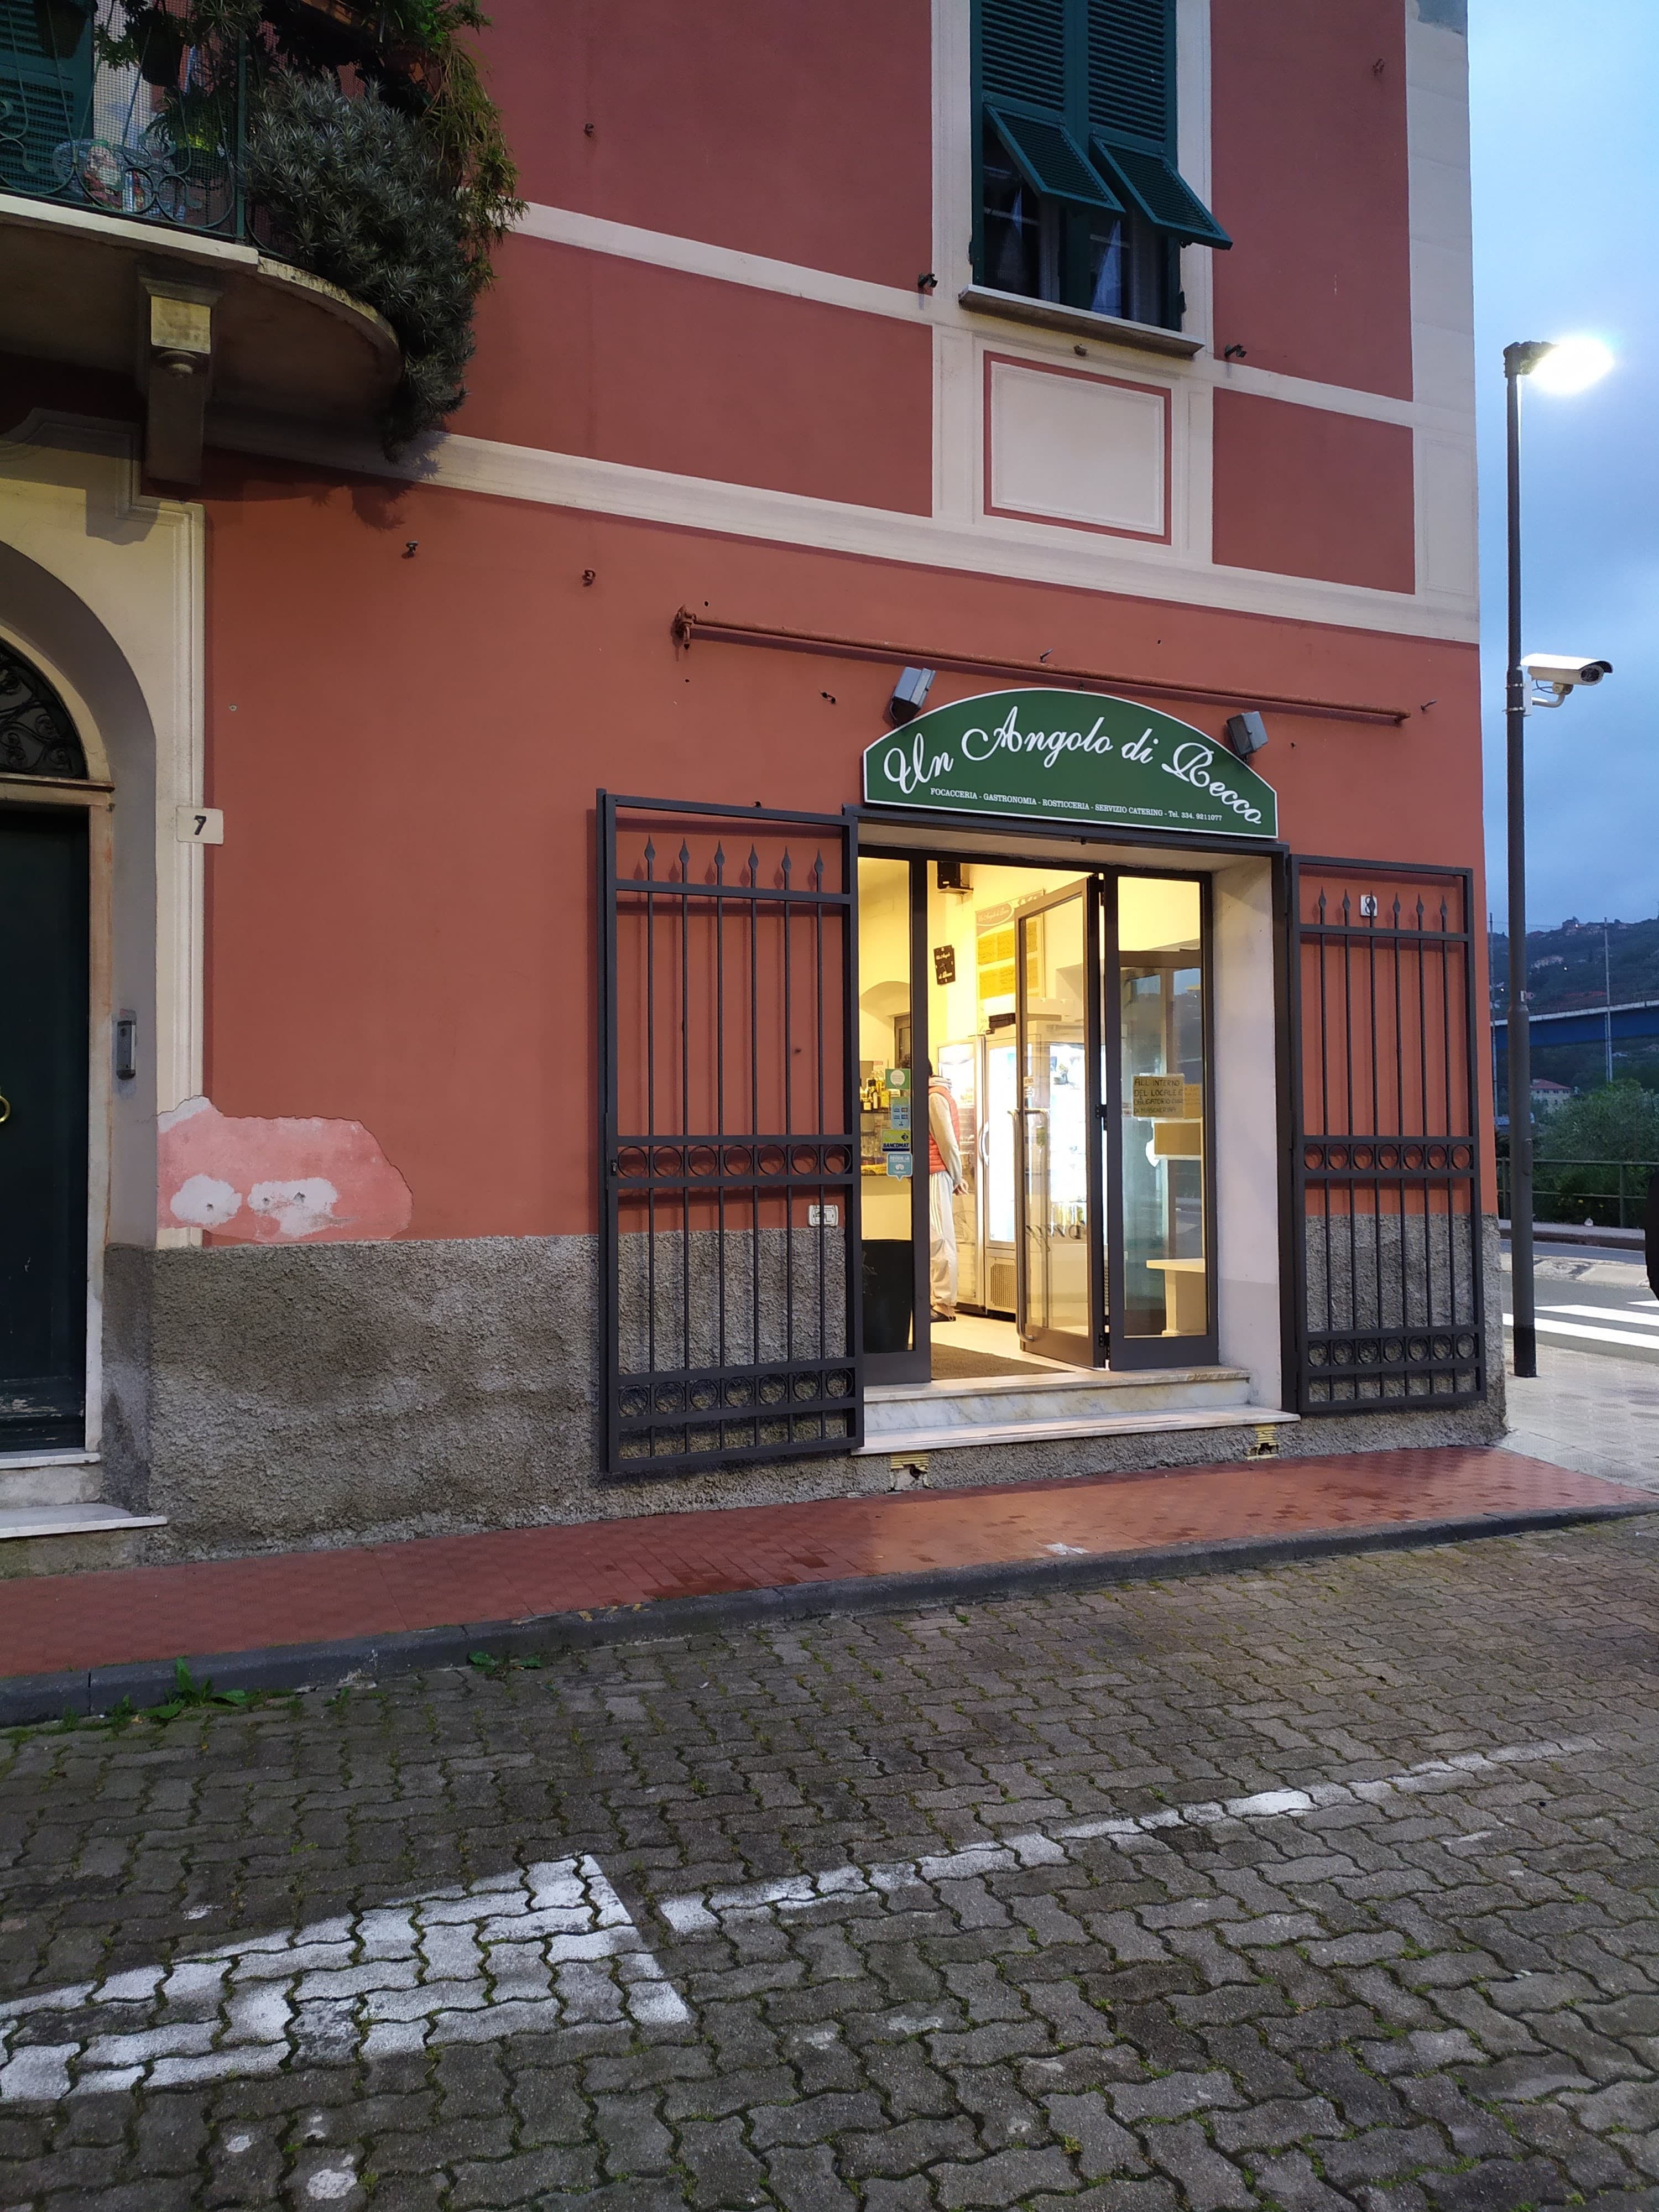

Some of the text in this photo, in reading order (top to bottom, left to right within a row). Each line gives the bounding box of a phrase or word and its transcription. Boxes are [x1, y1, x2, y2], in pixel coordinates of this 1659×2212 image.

[884, 706, 1262, 824] Un Angolo di Recco
[930, 787, 978, 800] FOCACCERIA
[983, 793, 1037, 805] GASTRONOMIA
[1042, 799, 1089, 810] ROSTICCERIA
[1095, 804, 1128, 813] SERVIZIO
[1128, 807, 1163, 816] CATERING
[1196, 813, 1222, 821] 9211077
[194, 815, 207, 836] 7
